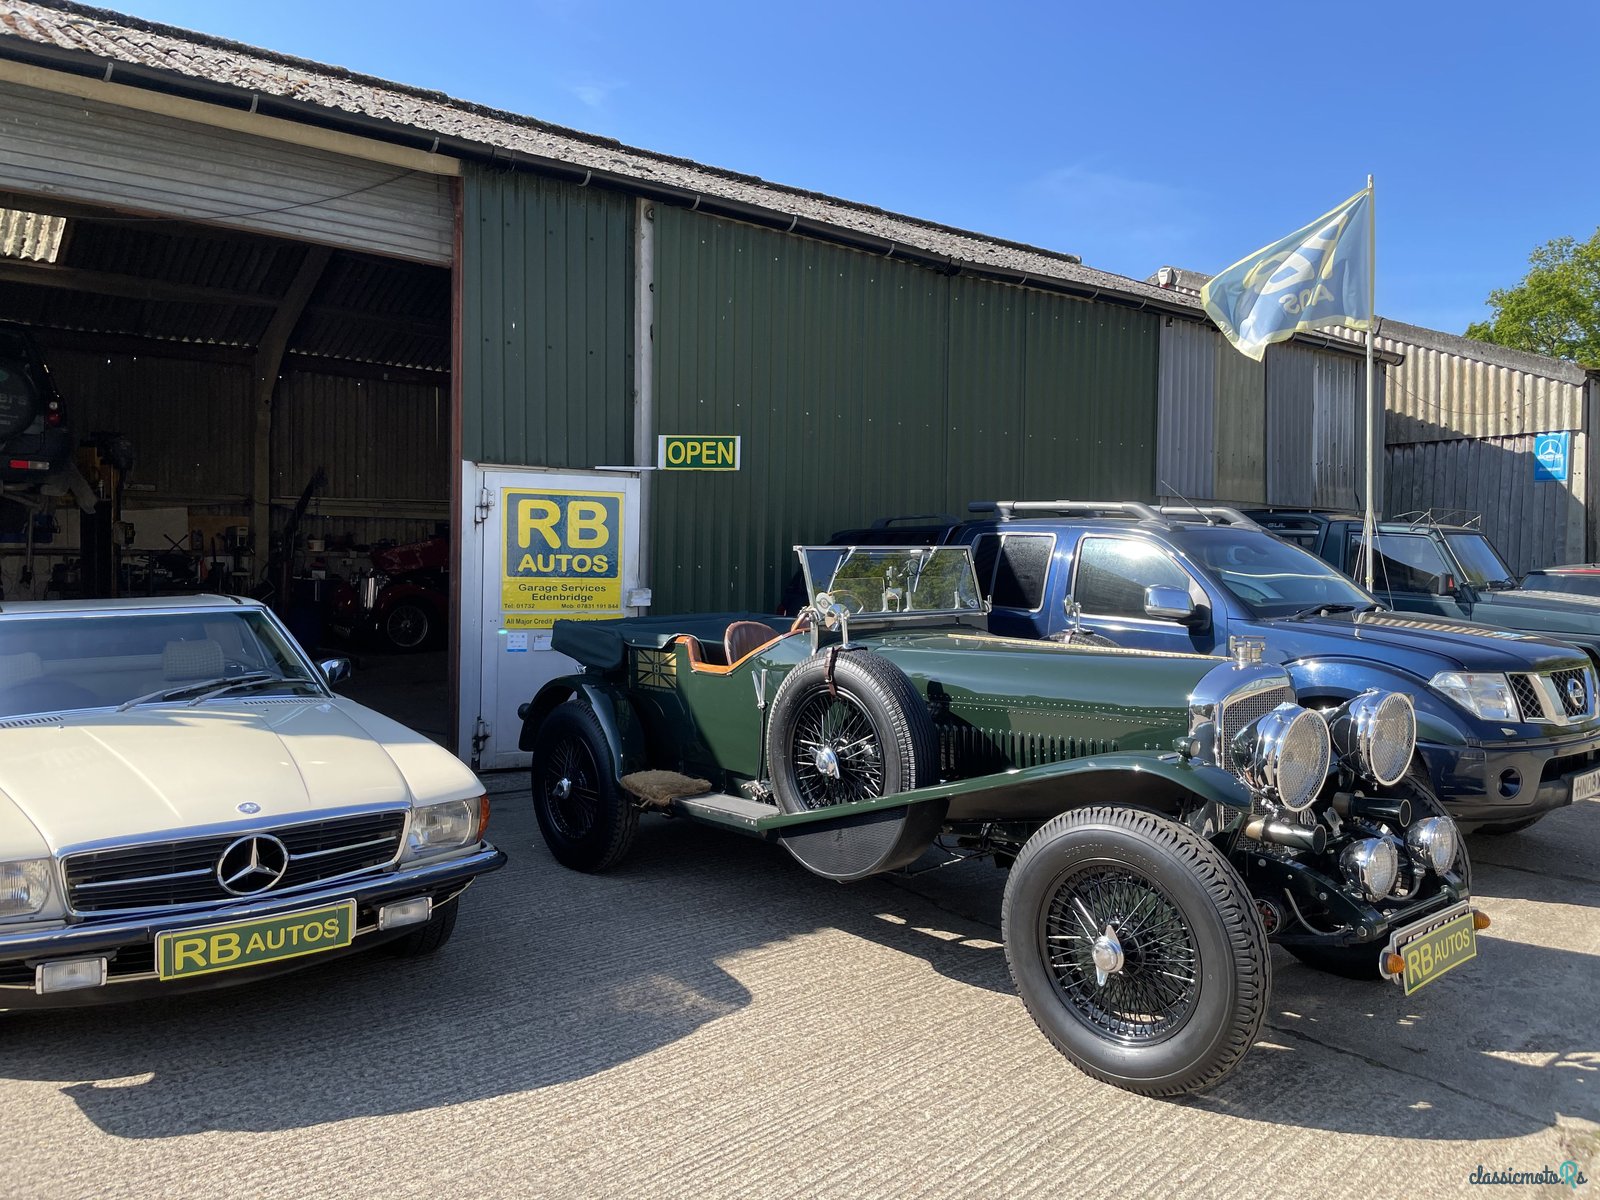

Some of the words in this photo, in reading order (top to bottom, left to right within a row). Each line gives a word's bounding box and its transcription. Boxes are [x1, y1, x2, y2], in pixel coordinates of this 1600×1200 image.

[667, 440, 734, 465] OPEN
[517, 498, 610, 550] RB
[517, 553, 609, 574] AUTOS
[518, 583, 558, 593] Garage
[561, 584, 607, 592] Services
[531, 593, 594, 602] Edenbridge
[516, 618, 532, 626] Major
[175, 932, 242, 971] RB
[245, 918, 340, 954] AUTOS
[1407, 942, 1434, 985] RB
[1434, 927, 1470, 965] AUTOS
